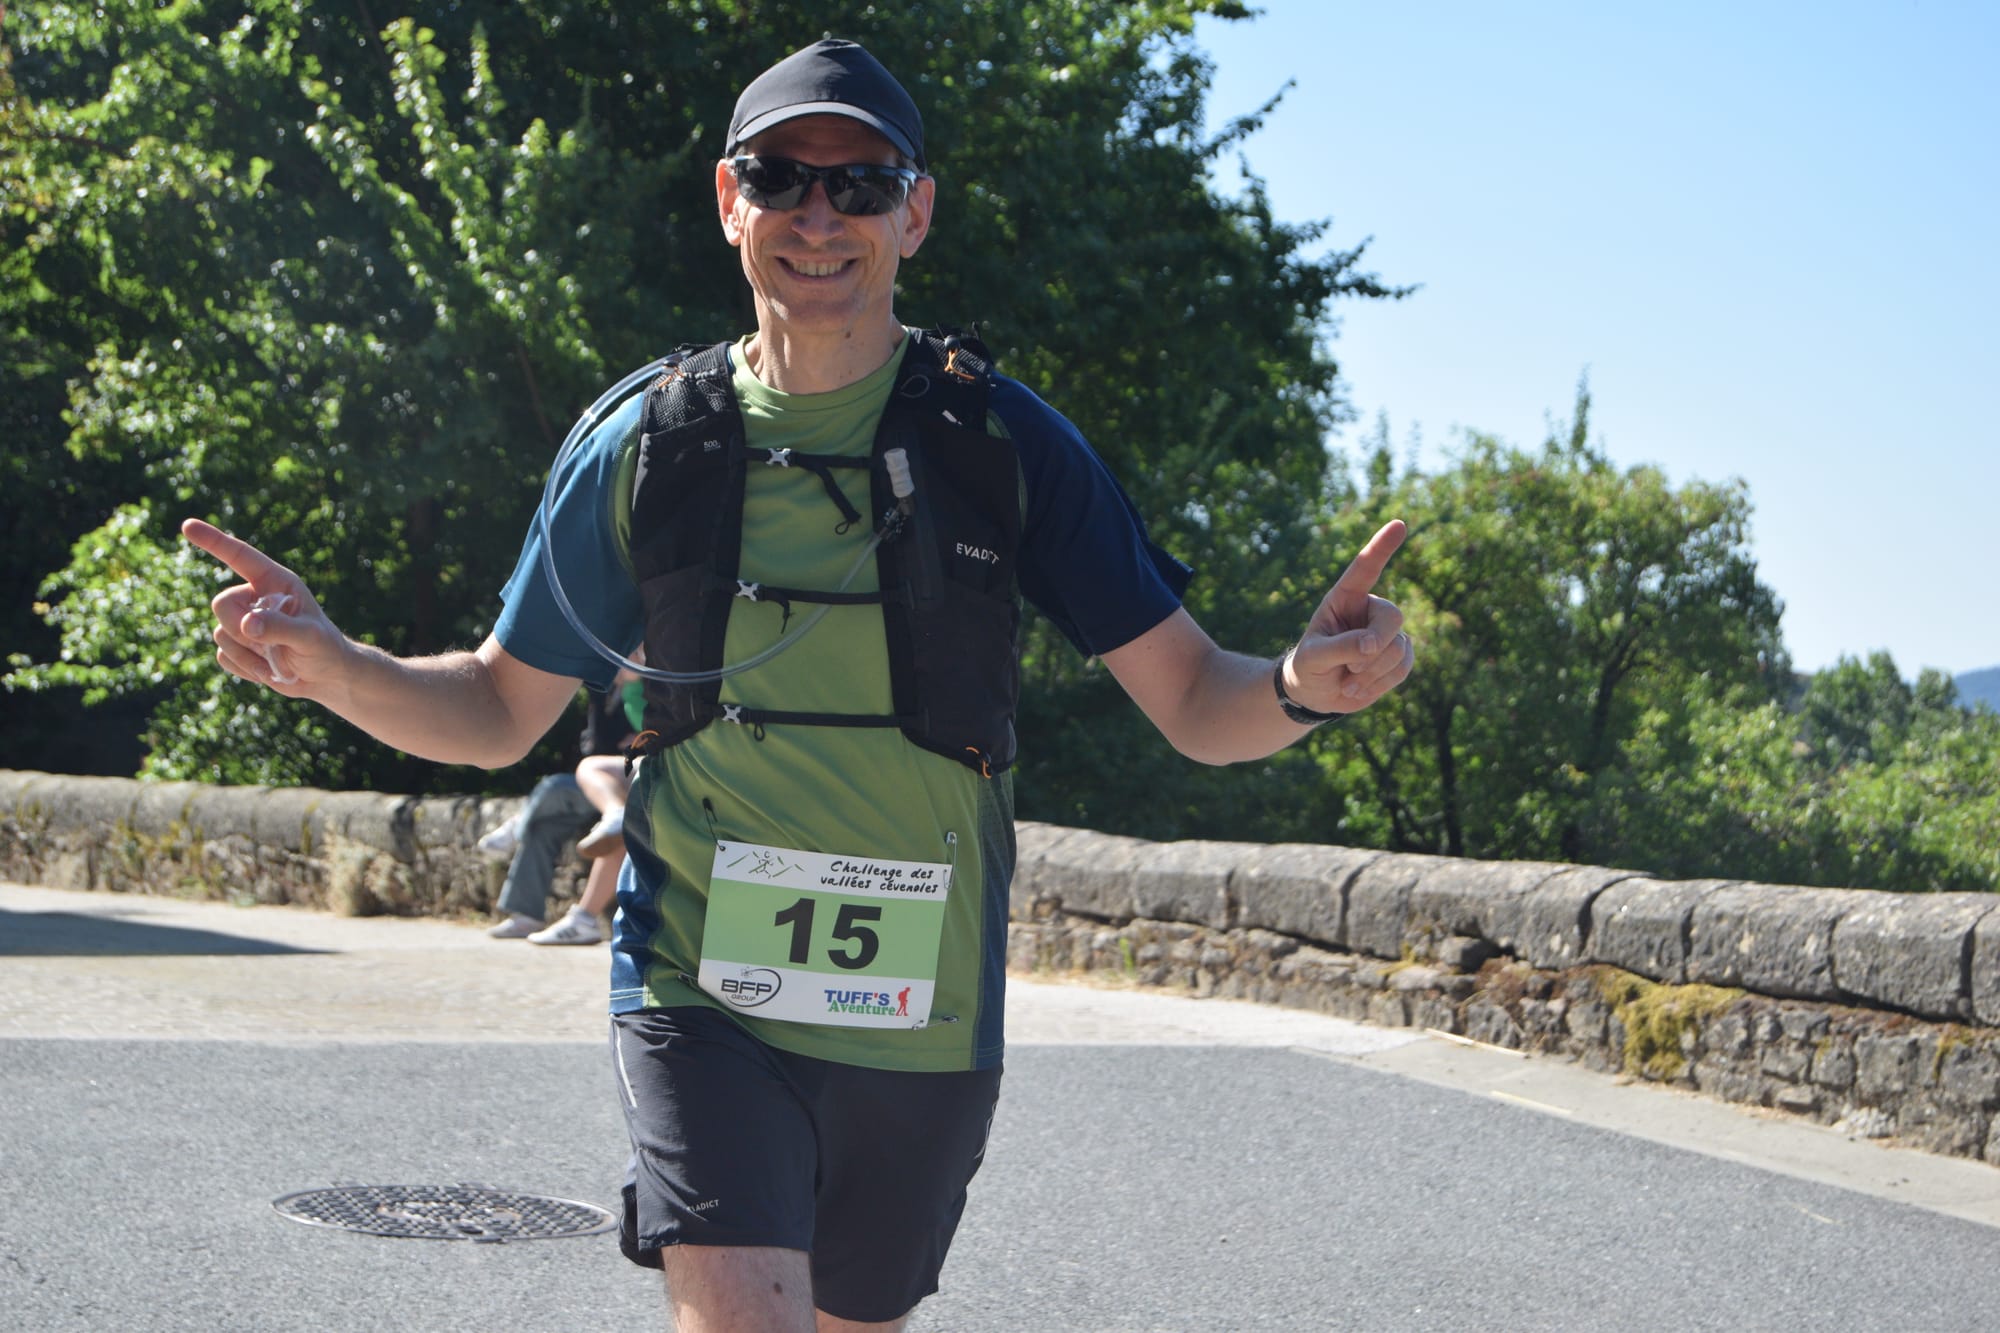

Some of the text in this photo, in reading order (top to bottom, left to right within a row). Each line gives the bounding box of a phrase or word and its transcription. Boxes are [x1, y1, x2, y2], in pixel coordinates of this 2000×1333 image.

[956, 542, 1000, 565] EVADT
[830, 860, 934, 880] Challenge des
[820, 875, 938, 893] vallées cévenoles
[774, 897, 882, 970] 15
[721, 979, 772, 996] BFP
[731, 993, 756, 1002] GROUP
[823, 989, 890, 1006] TUFF'S
[828, 1000, 896, 1017] Aventure
